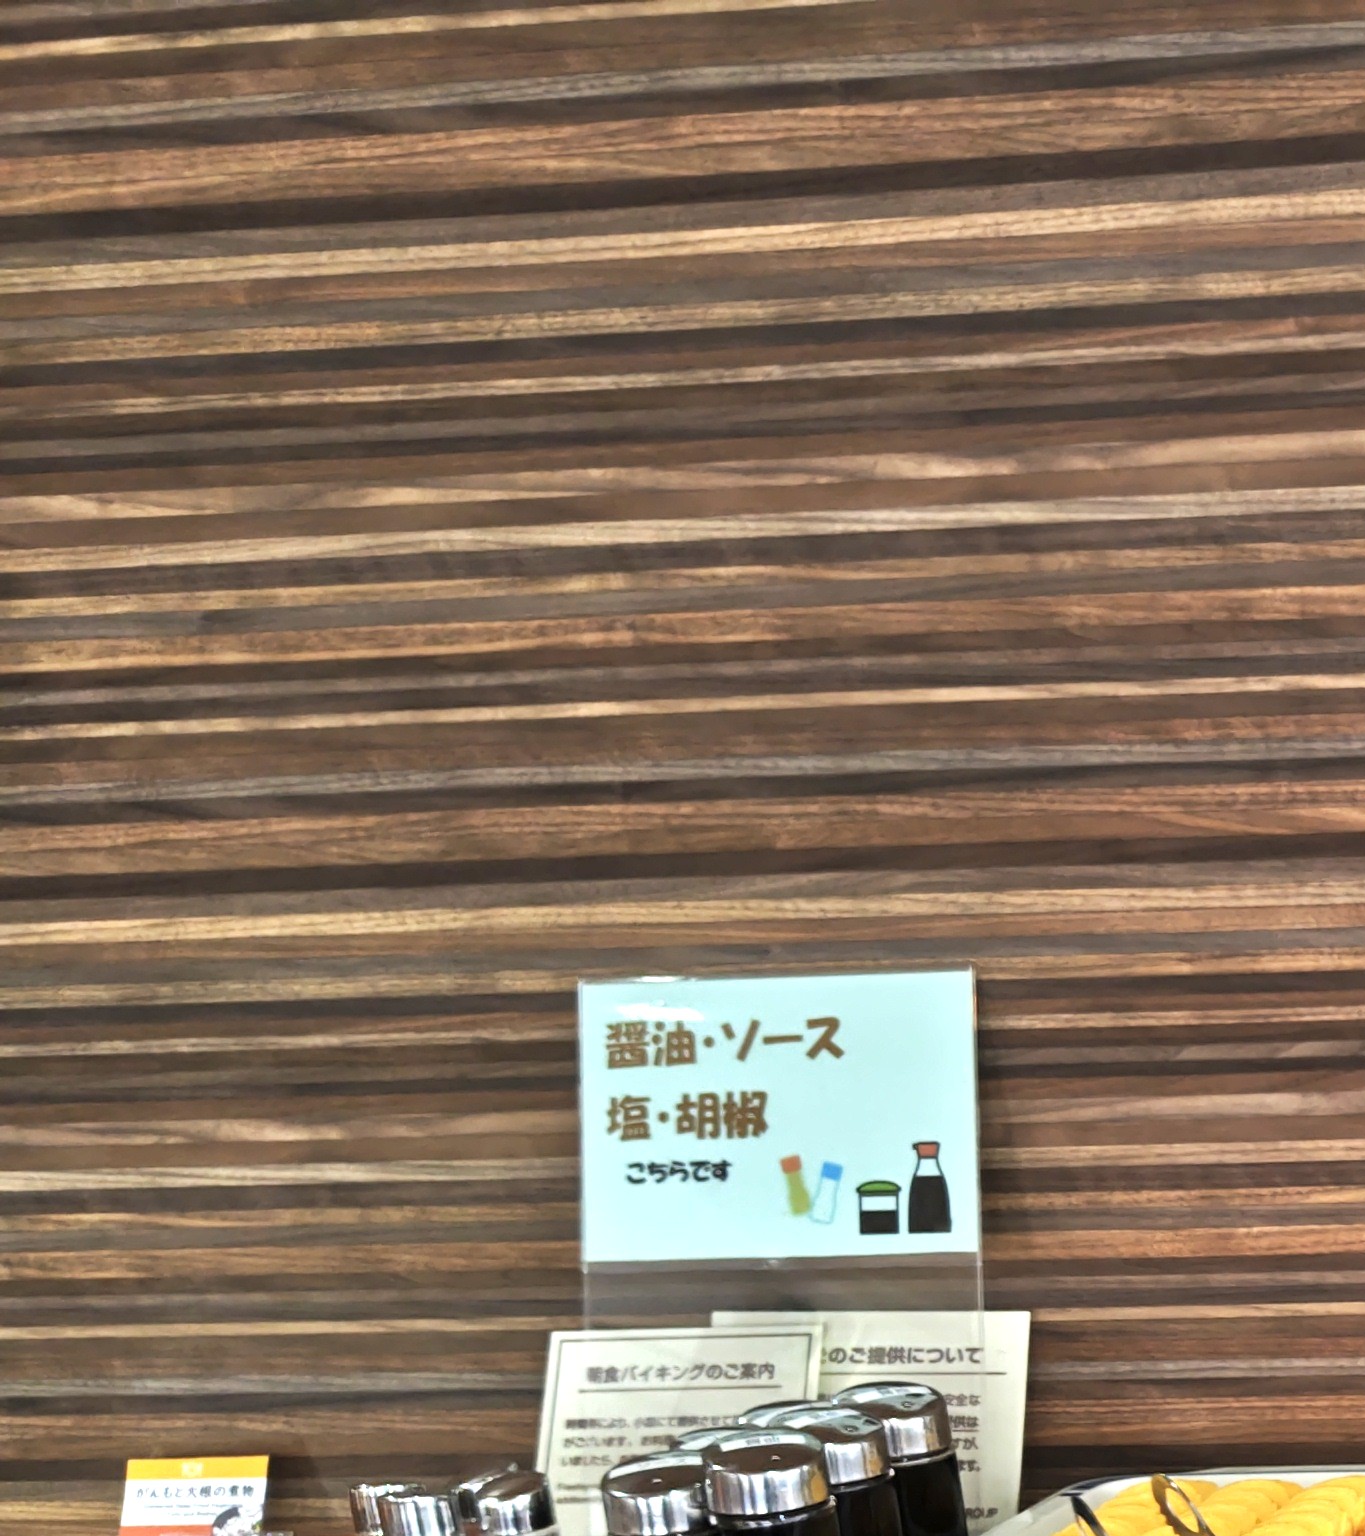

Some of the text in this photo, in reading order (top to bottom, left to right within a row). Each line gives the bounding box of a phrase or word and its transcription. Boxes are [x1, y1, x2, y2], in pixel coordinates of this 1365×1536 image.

[606, 1016, 845, 1069] 醤油・ソース
[606, 1091, 769, 1142] 塩・胡椒
[626, 1159, 731, 1184] こちらです
[822, 1346, 984, 1366] のご提供について
[586, 1361, 776, 1384] 朝食バイキングのご案内
